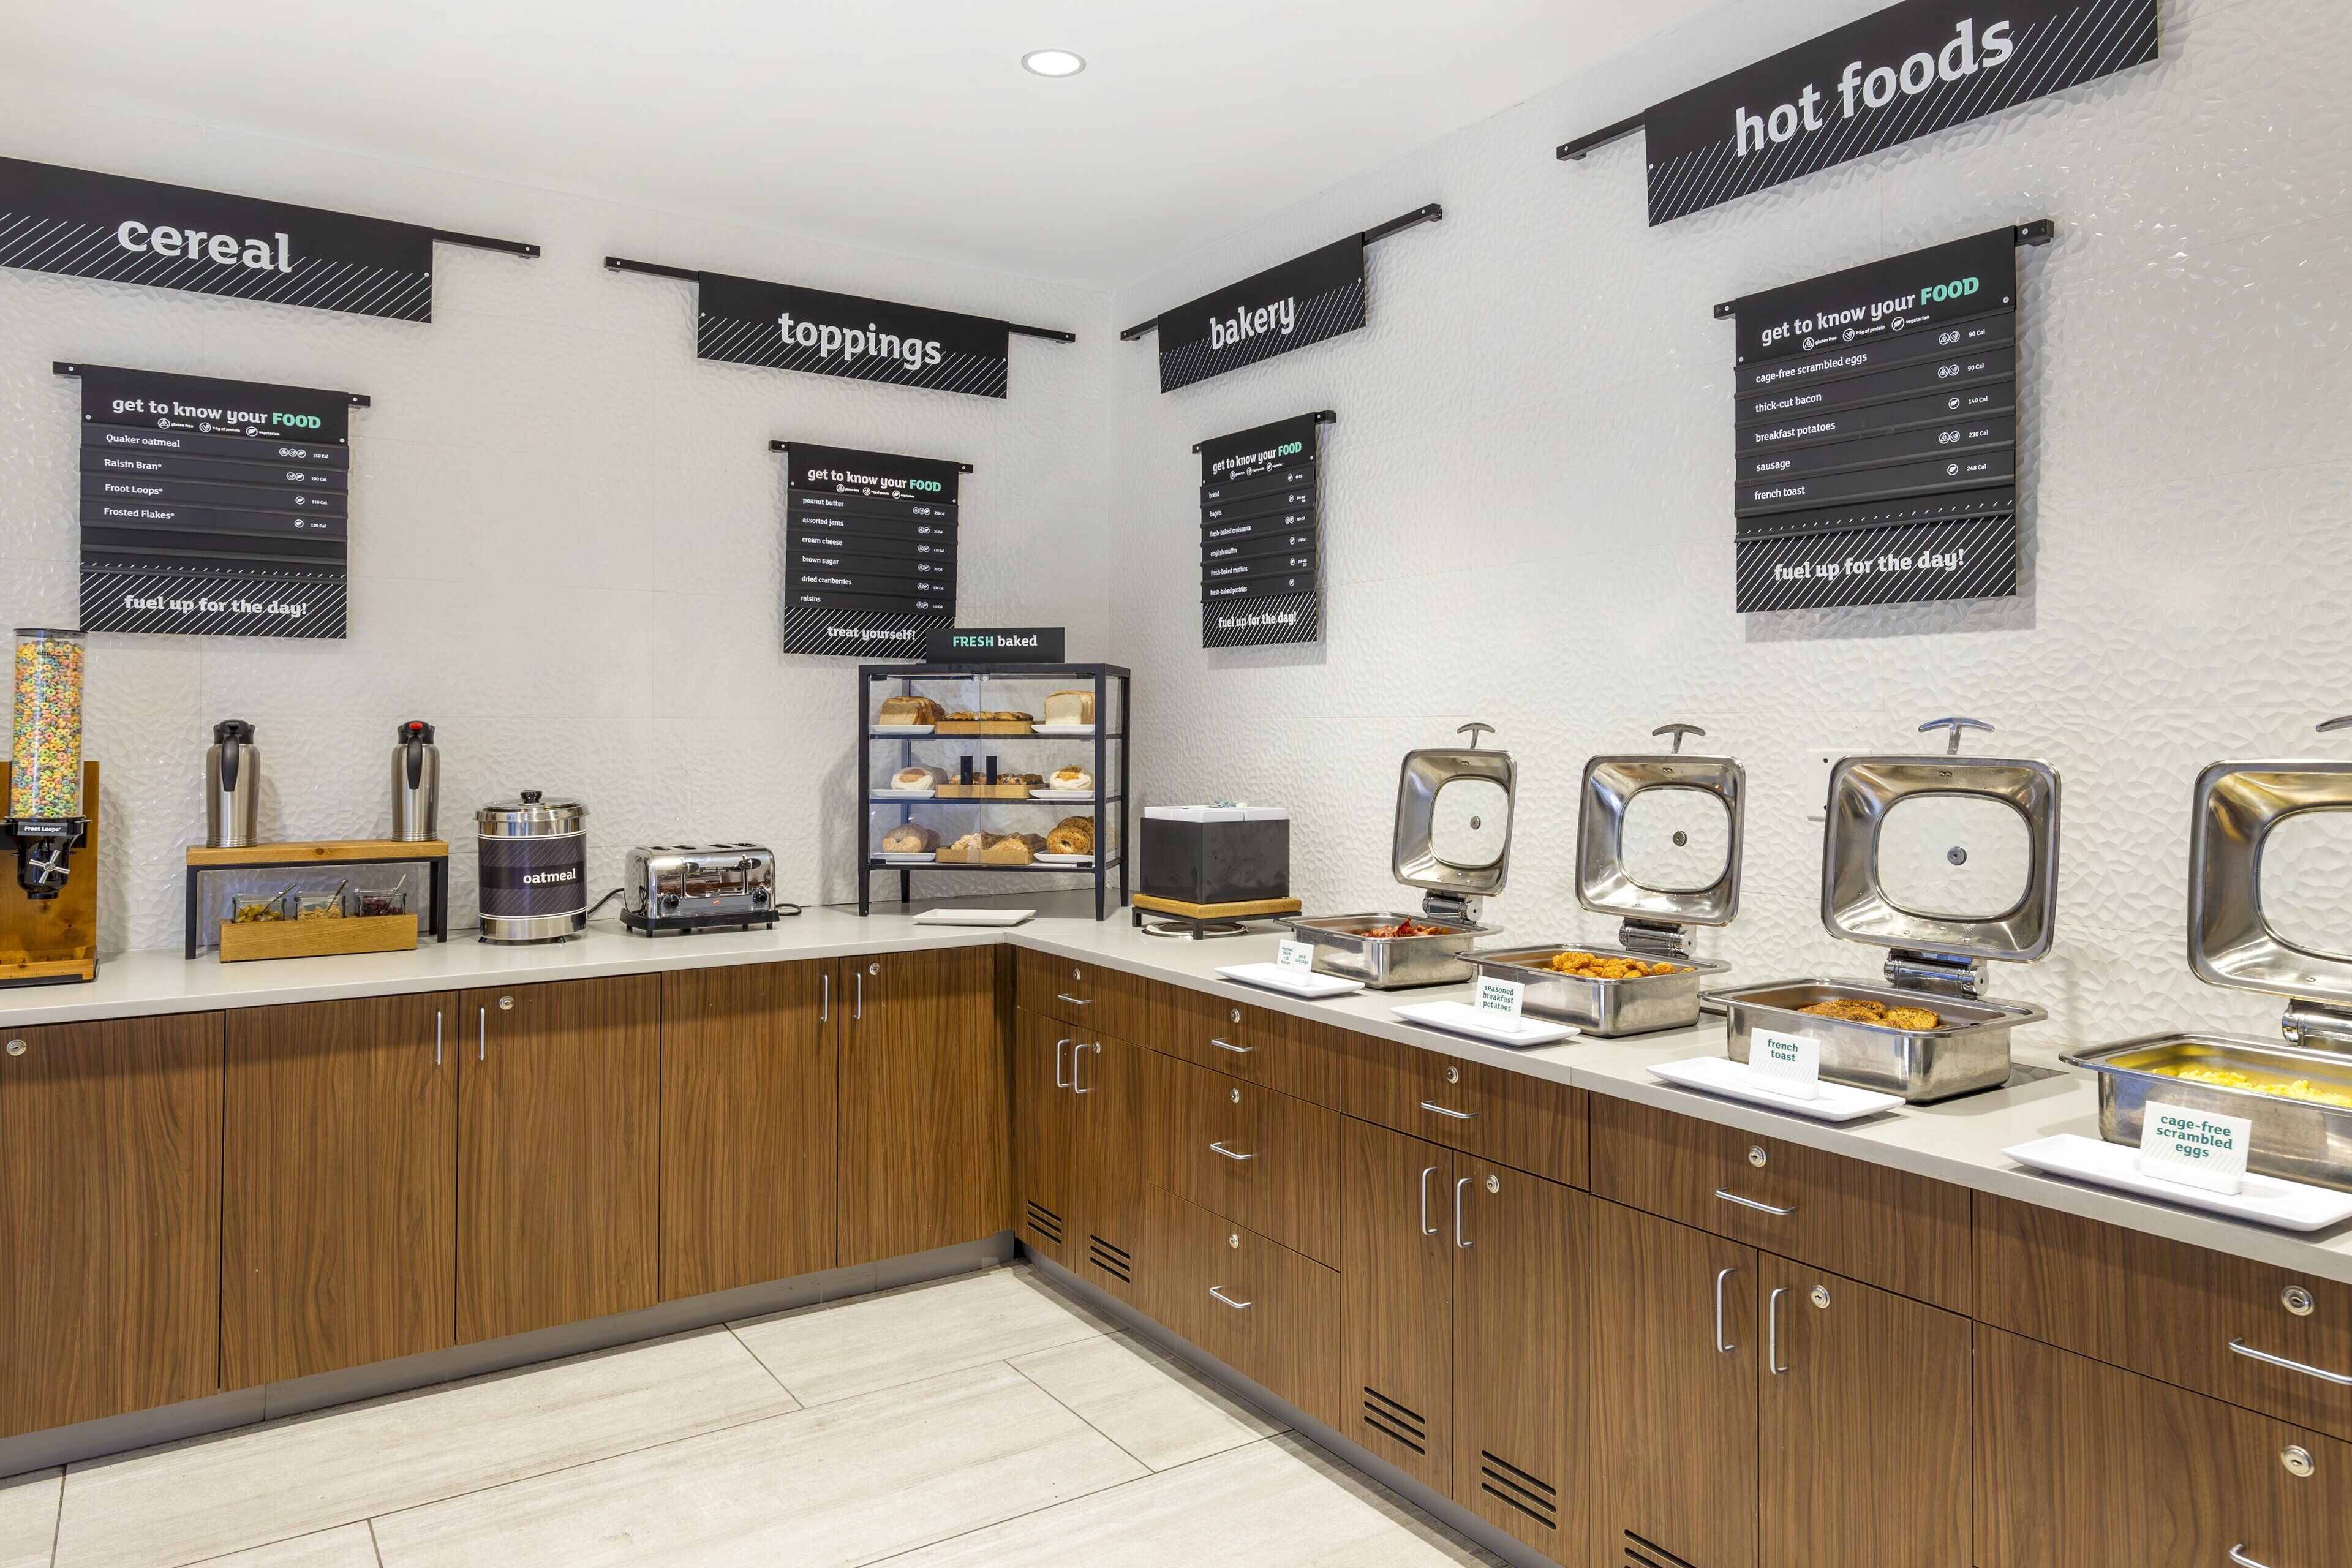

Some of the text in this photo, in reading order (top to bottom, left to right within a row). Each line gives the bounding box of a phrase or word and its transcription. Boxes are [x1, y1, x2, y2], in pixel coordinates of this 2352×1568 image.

[1736, 17, 2013, 157] hot foods
[118, 221, 292, 273] cereal
[1762, 276, 1979, 346] get to know your FOOD
[1210, 296, 1295, 350] bakery
[1906, 315, 1929, 324] vegetarian
[1870, 325, 1886, 334] protein
[778, 312, 941, 371] toppings
[1815, 337, 1828, 345] gluten
[1756, 353, 1868, 383] cage-free scrambled eggs
[1755, 394, 1822, 413] thick-cut bacon
[112, 399, 321, 428] get to know your FOOD
[1755, 422, 1836, 442] breakfast potatoes
[106, 434, 181, 448] Quaker oatmeal
[104, 459, 134, 469] Raisin
[1213, 441, 1302, 475] get to know your FOOD
[1756, 460, 1790, 472] sausage
[808, 469, 941, 492] get to know your FOOD
[105, 484, 130, 493] Froot
[1755, 486, 1806, 500] french toast
[802, 497, 843, 507] peanut butter
[104, 507, 139, 518] Frosted
[802, 517, 827, 526] assorted
[1210, 525, 1251, 537] fresh-baked croissants
[822, 537, 843, 546] cheese
[1210, 549, 1224, 557] english
[1211, 567, 1232, 576] fresh-baked
[1774, 548, 1965, 582] fuel up for the day!
[818, 576, 852, 585] cranberries
[1210, 586, 1248, 595] fresh-baked pastries
[124, 595, 306, 617] fuel up for the day!
[1219, 611, 1297, 628] fuel up for the day!
[827, 625, 916, 641] treat yourself!
[953, 635, 1038, 647] FRESH baked
[523, 868, 576, 883] oatmeal
[1485, 985, 1514, 995] seasoned
[1483, 991, 1513, 1004] breakfast
[1483, 1001, 1511, 1011] potatoes
[1768, 1039, 1798, 1052] french
[1771, 1050, 1796, 1061] toast
[2160, 1116, 2231, 1136] cage-free
[2156, 1127, 2233, 1150] scrambled
[2176, 1144, 2209, 1158] eggs
